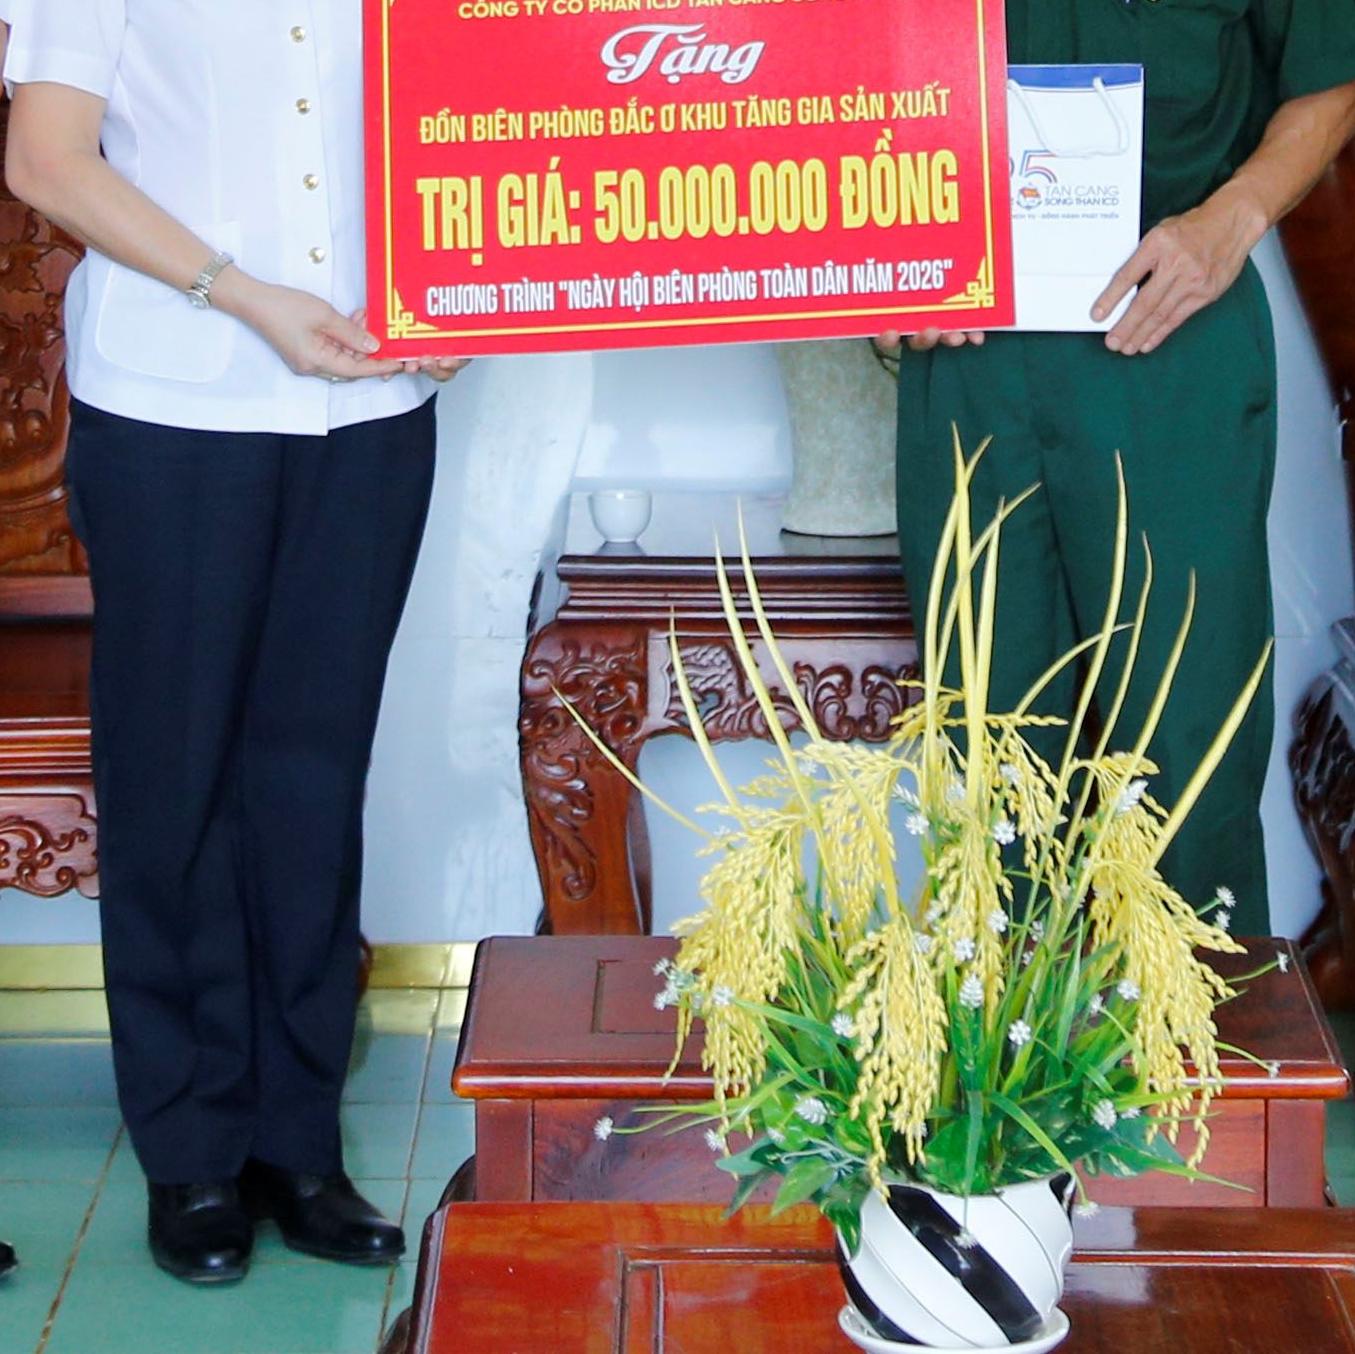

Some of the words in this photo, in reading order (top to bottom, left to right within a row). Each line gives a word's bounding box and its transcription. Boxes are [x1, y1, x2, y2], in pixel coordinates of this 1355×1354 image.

[599, 22, 766, 85] Tặng
[420, 107, 466, 144] ĐỒN
[472, 108, 524, 142] BIÊN
[529, 104, 605, 140] PHÒNG
[609, 96, 655, 135] ĐẮC
[660, 103, 677, 133] Ơ
[680, 102, 727, 132] KHU
[732, 95, 792, 128] TĂNG
[797, 96, 835, 126] GIA
[840, 85, 886, 122] SẢN
[891, 80, 951, 119] XUẤT
[415, 175, 484, 266] TRỊ
[497, 156, 582, 249] GIÁ:
[594, 157, 829, 244] 50.000.000
[839, 128, 960, 229] ĐỒNG
[426, 282, 498, 317] CHƯƠNG
[501, 276, 555, 313] TRÌNH
[558, 273, 616, 310] "NGÀY
[619, 270, 648, 312] HỘI
[652, 268, 694, 306] BIÊN
[698, 265, 758, 303] PHÒNG
[760, 262, 808, 300] TOÀN
[811, 259, 849, 296] DÂN
[852, 257, 893, 294] NĂM
[896, 258, 954, 291] 2026"
